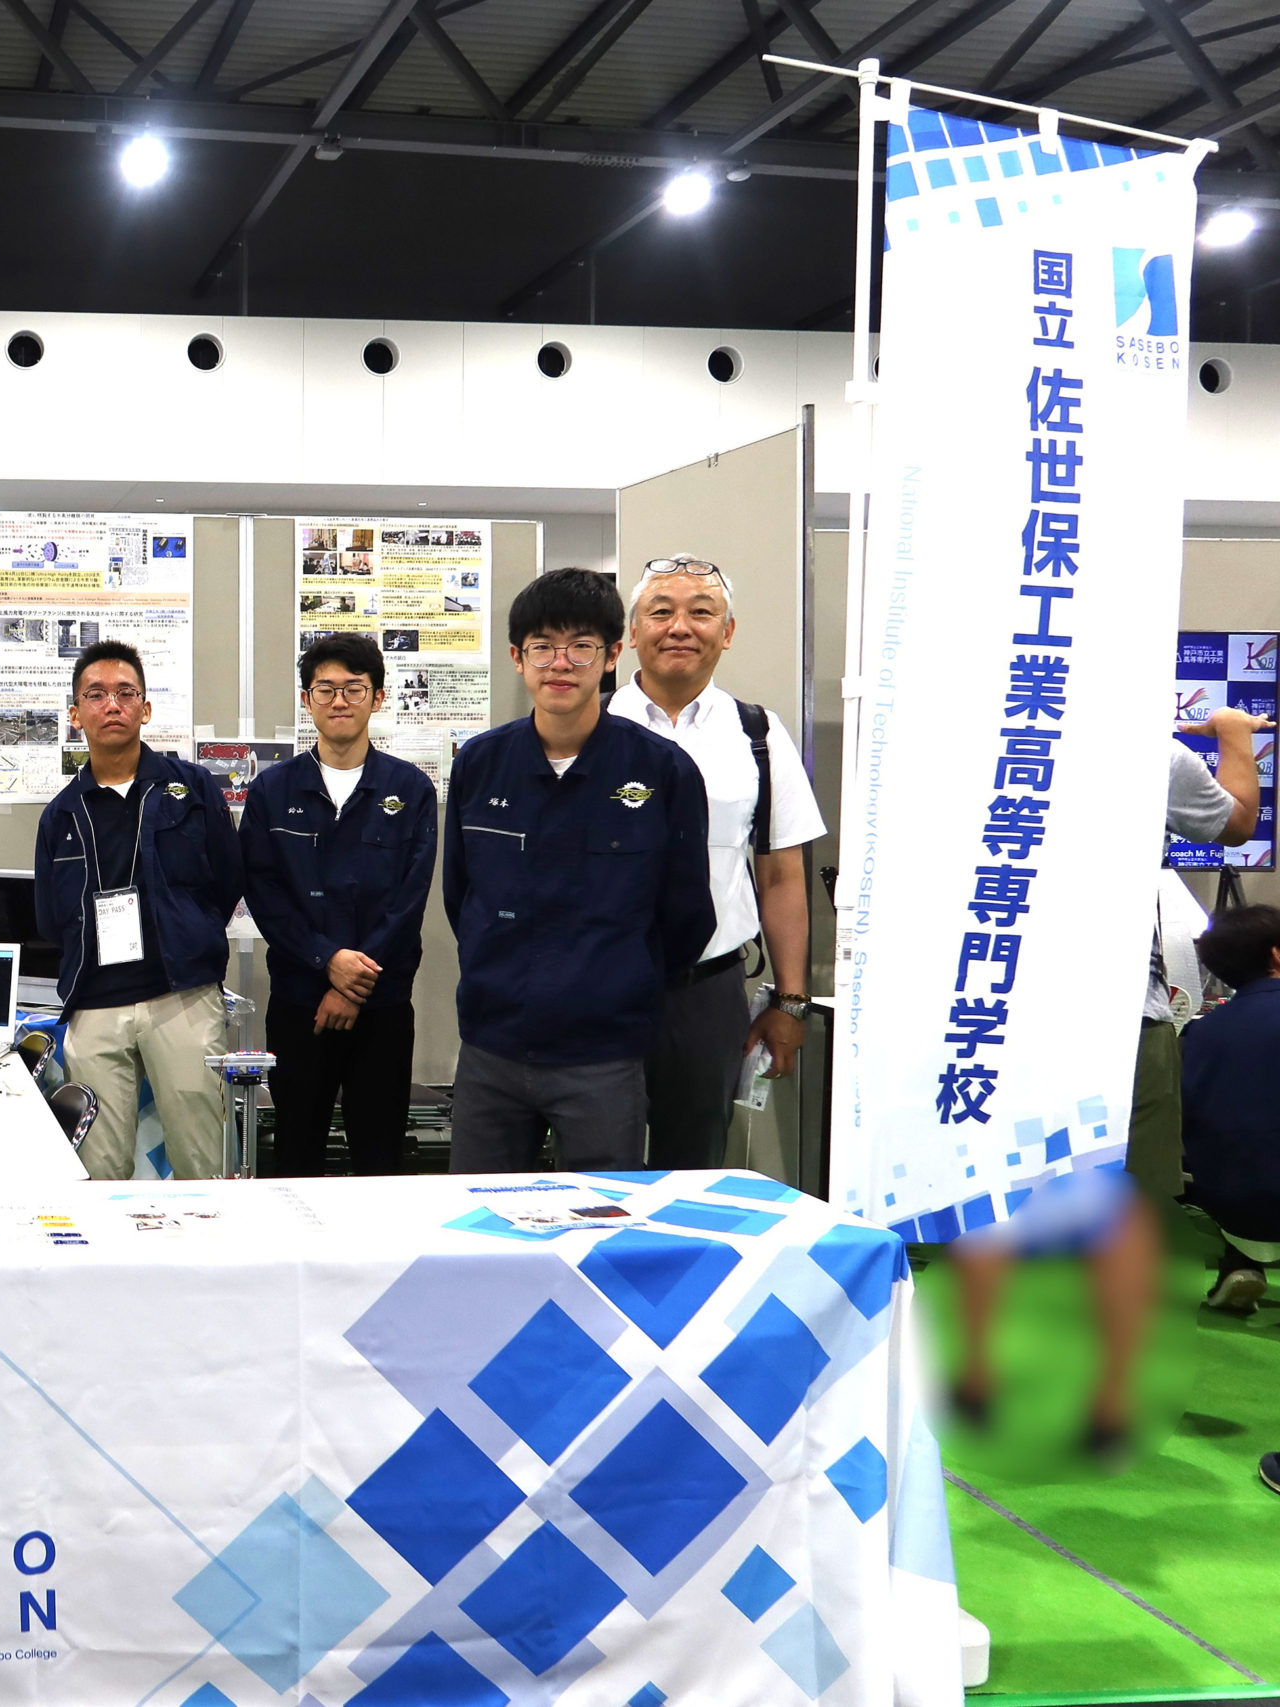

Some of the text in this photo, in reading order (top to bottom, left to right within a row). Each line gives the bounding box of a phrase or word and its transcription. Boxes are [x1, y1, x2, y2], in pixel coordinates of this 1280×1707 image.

[1116, 336, 1180, 355] SASEBO
[1116, 351, 1181, 370] KOSEN
[895, 464, 922, 566] National
[881, 571, 914, 661] Institute
[1183, 656, 1223, 664] 高等専門学校
[877, 667, 895, 693] of
[936, 249, 1084, 1125] 国立 佐世保工業高等専門学校
[1170, 849, 1194, 857] coach
[1195, 849, 1208, 857] Mr.
[849, 951, 867, 1035] Sasebo
[15, 1647, 58, 1661] College
